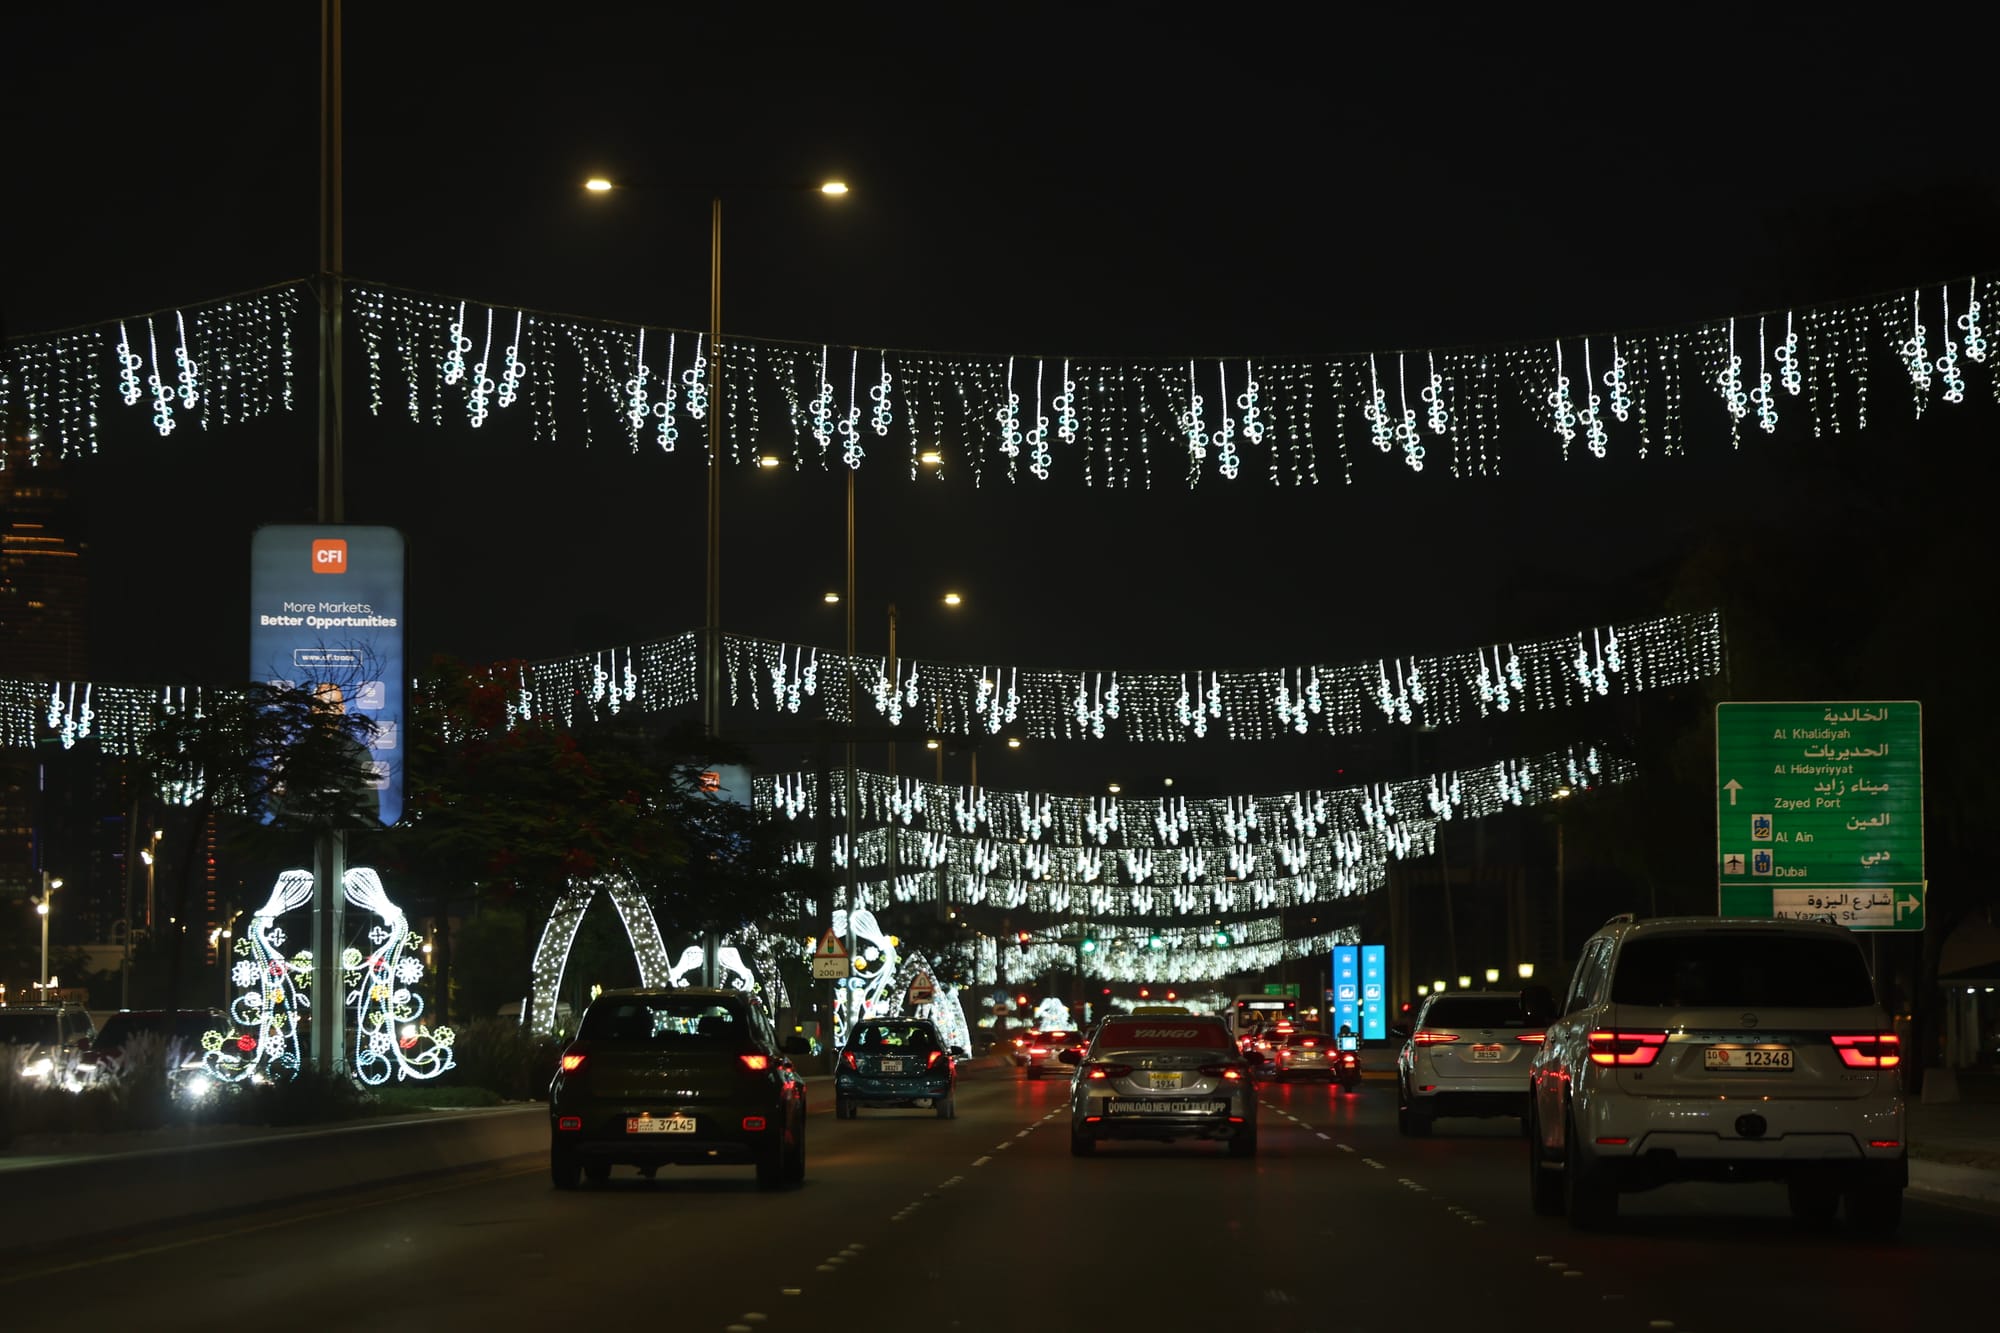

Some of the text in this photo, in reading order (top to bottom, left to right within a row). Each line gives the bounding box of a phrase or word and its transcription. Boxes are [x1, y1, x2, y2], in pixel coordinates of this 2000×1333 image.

[317, 550, 342, 563] CFI
[283, 602, 374, 615] More Markets,
[260, 615, 397, 629] Better Opportunities
[1824, 707, 1888, 725] الخالدية
[1774, 728, 1850, 741] Al Khalidiyah
[1804, 743, 1888, 761] الحديريات
[1774, 764, 1853, 776] Al Hidayriyyat
[1814, 777, 1889, 796] ميناء زايد
[1774, 797, 1841, 810] Zayed Port
[1846, 813, 1890, 831] العين
[1775, 832, 1814, 842] Al Ain
[1861, 850, 1890, 869] دبي
[1775, 866, 1807, 877] Dubai
[1808, 894, 1891, 910] شارع اليزوة
[819, 969, 835, 977] 200
[1133, 1029, 1199, 1039] YANGO
[1745, 1052, 1789, 1066] 12348
[1108, 1102, 1152, 1112] DOWNLOAD
[1153, 1102, 1171, 1112] NEW
[1172, 1102, 1190, 1112] CITY
[1209, 1102, 1226, 1112] APP
[658, 1120, 694, 1131] 37145
